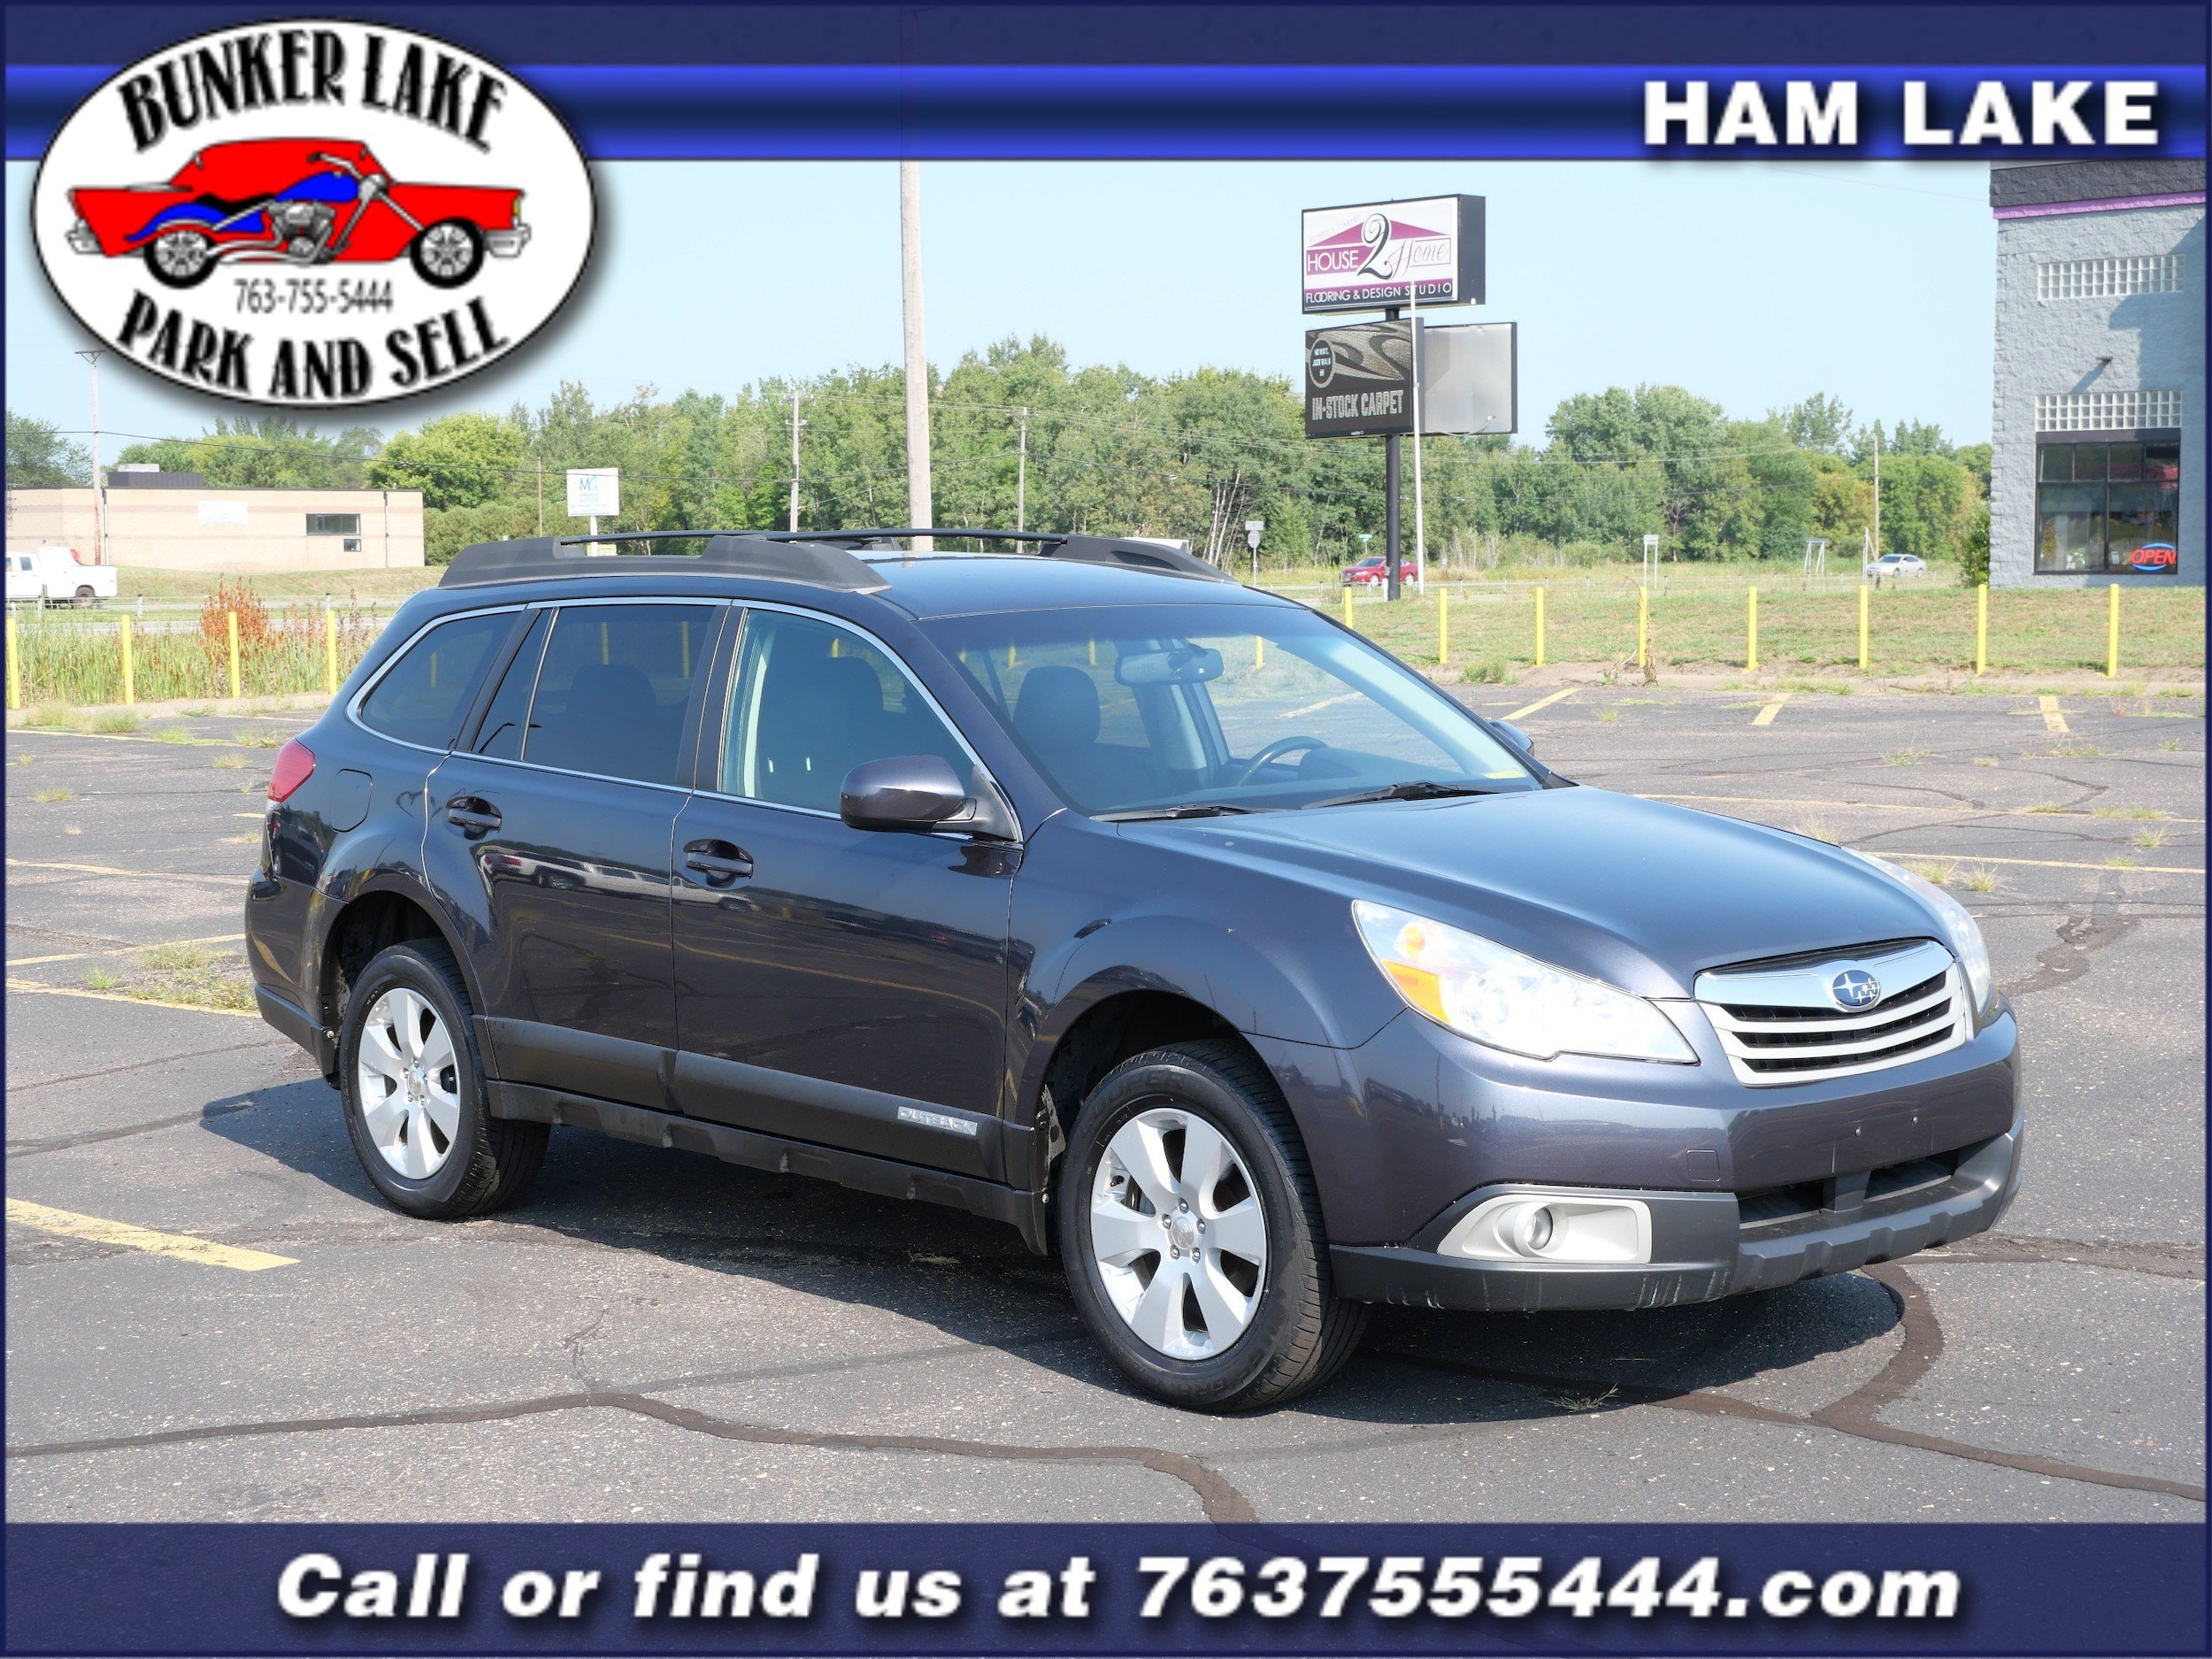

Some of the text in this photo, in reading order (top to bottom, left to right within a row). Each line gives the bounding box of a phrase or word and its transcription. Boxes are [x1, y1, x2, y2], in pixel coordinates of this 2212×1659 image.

[1307, 213, 1446, 280] HOUSE 2 Home
[1306, 288, 1350, 303] FLOORING
[1353, 289, 1360, 300] &
[1362, 287, 1401, 299] DESIGN
[1312, 389, 1403, 420] IN-STOCK CARPET
[2131, 549, 2177, 565] OPEN
